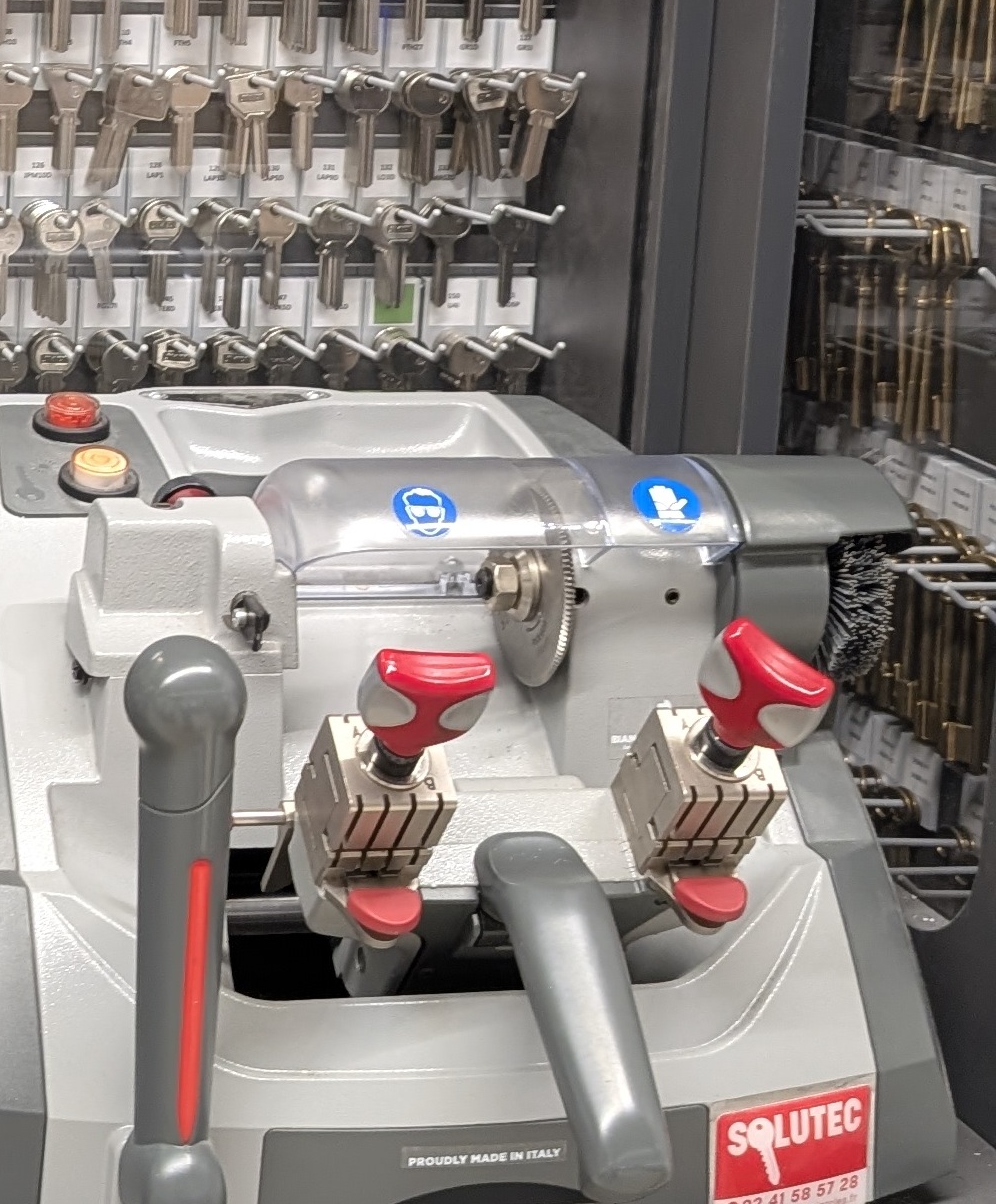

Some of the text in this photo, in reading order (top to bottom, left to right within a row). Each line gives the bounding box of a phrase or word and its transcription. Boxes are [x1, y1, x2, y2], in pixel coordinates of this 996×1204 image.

[726, 1097, 862, 1162] SOLUTEC
[407, 1147, 562, 1166] PROUDLY MADE IN ITALY
[769, 1191, 785, 1204] 41
[791, 1187, 811, 1202] 58
[816, 1181, 835, 1197] 57
[839, 1175, 859, 1192] 28
